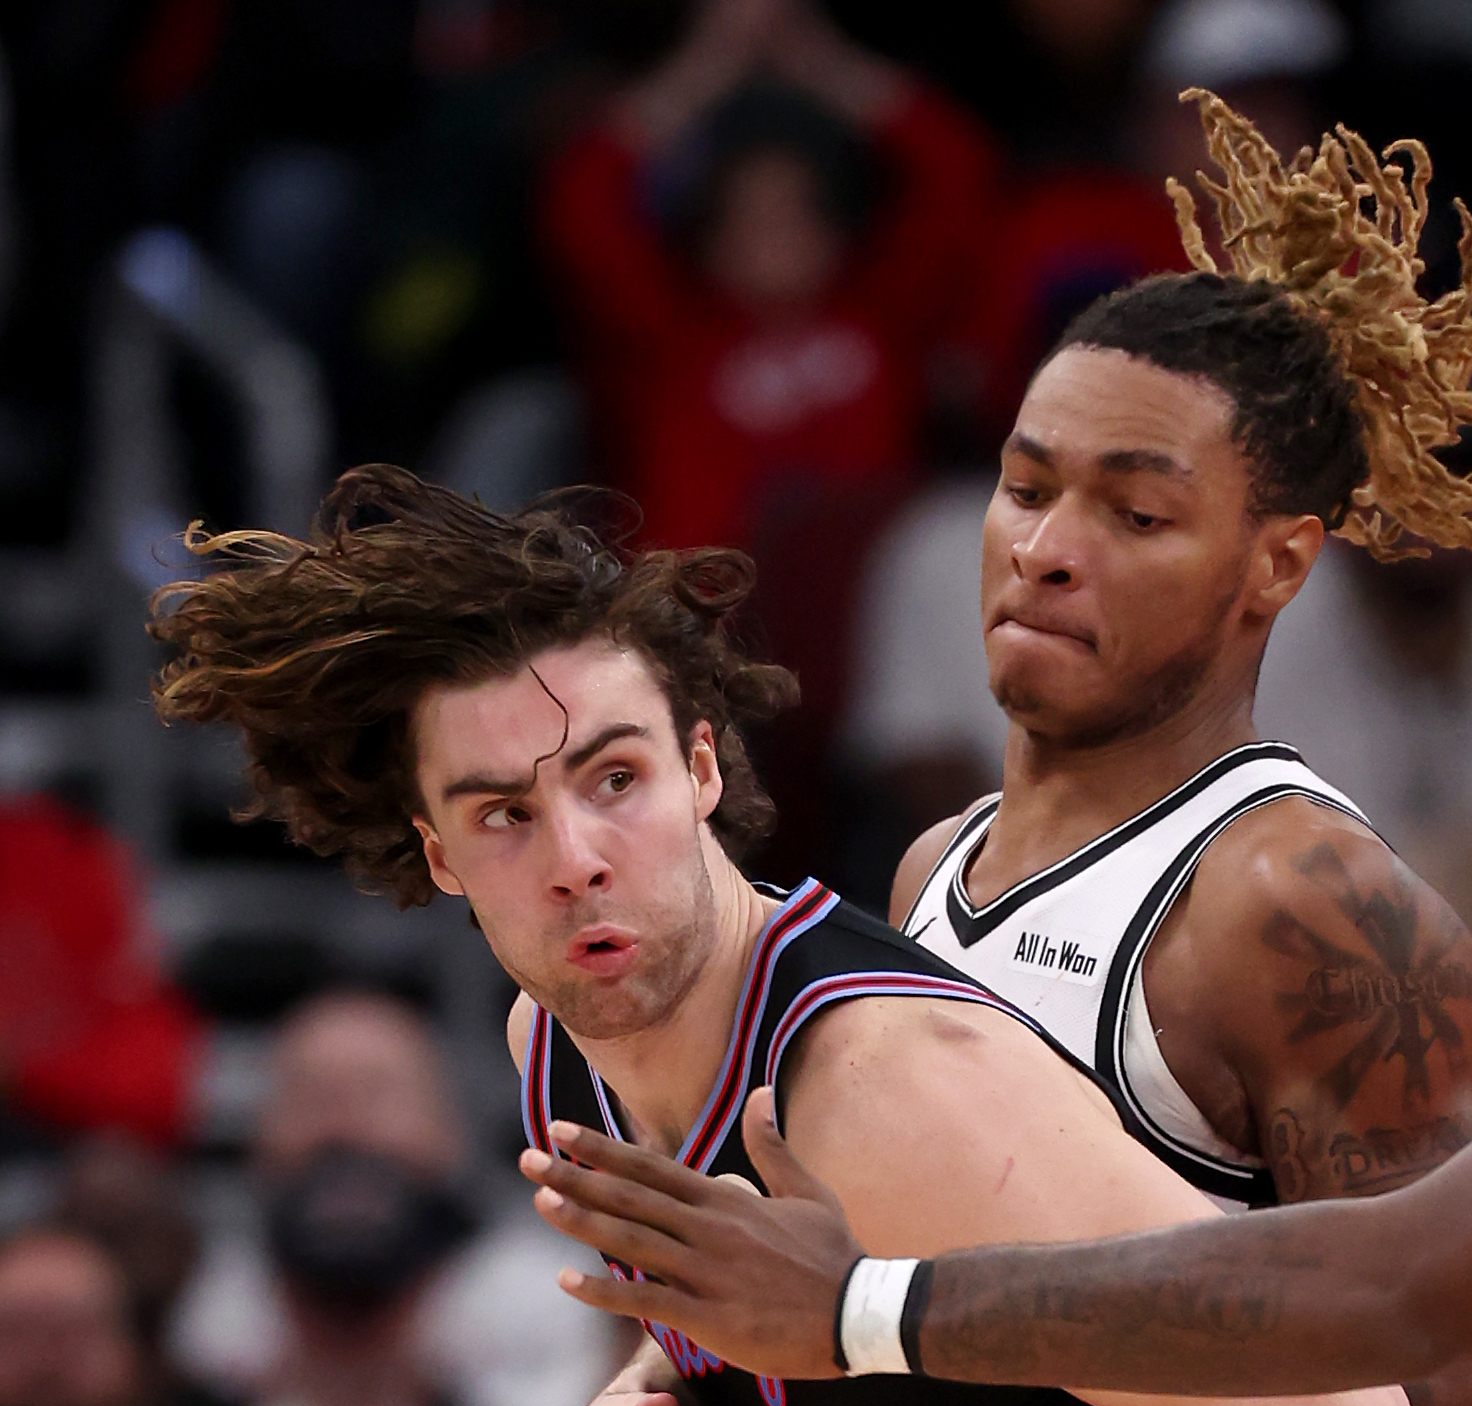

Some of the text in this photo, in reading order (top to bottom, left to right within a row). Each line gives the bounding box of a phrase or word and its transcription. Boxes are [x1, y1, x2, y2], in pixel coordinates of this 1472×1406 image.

[1013, 931, 1098, 977] All In Won
